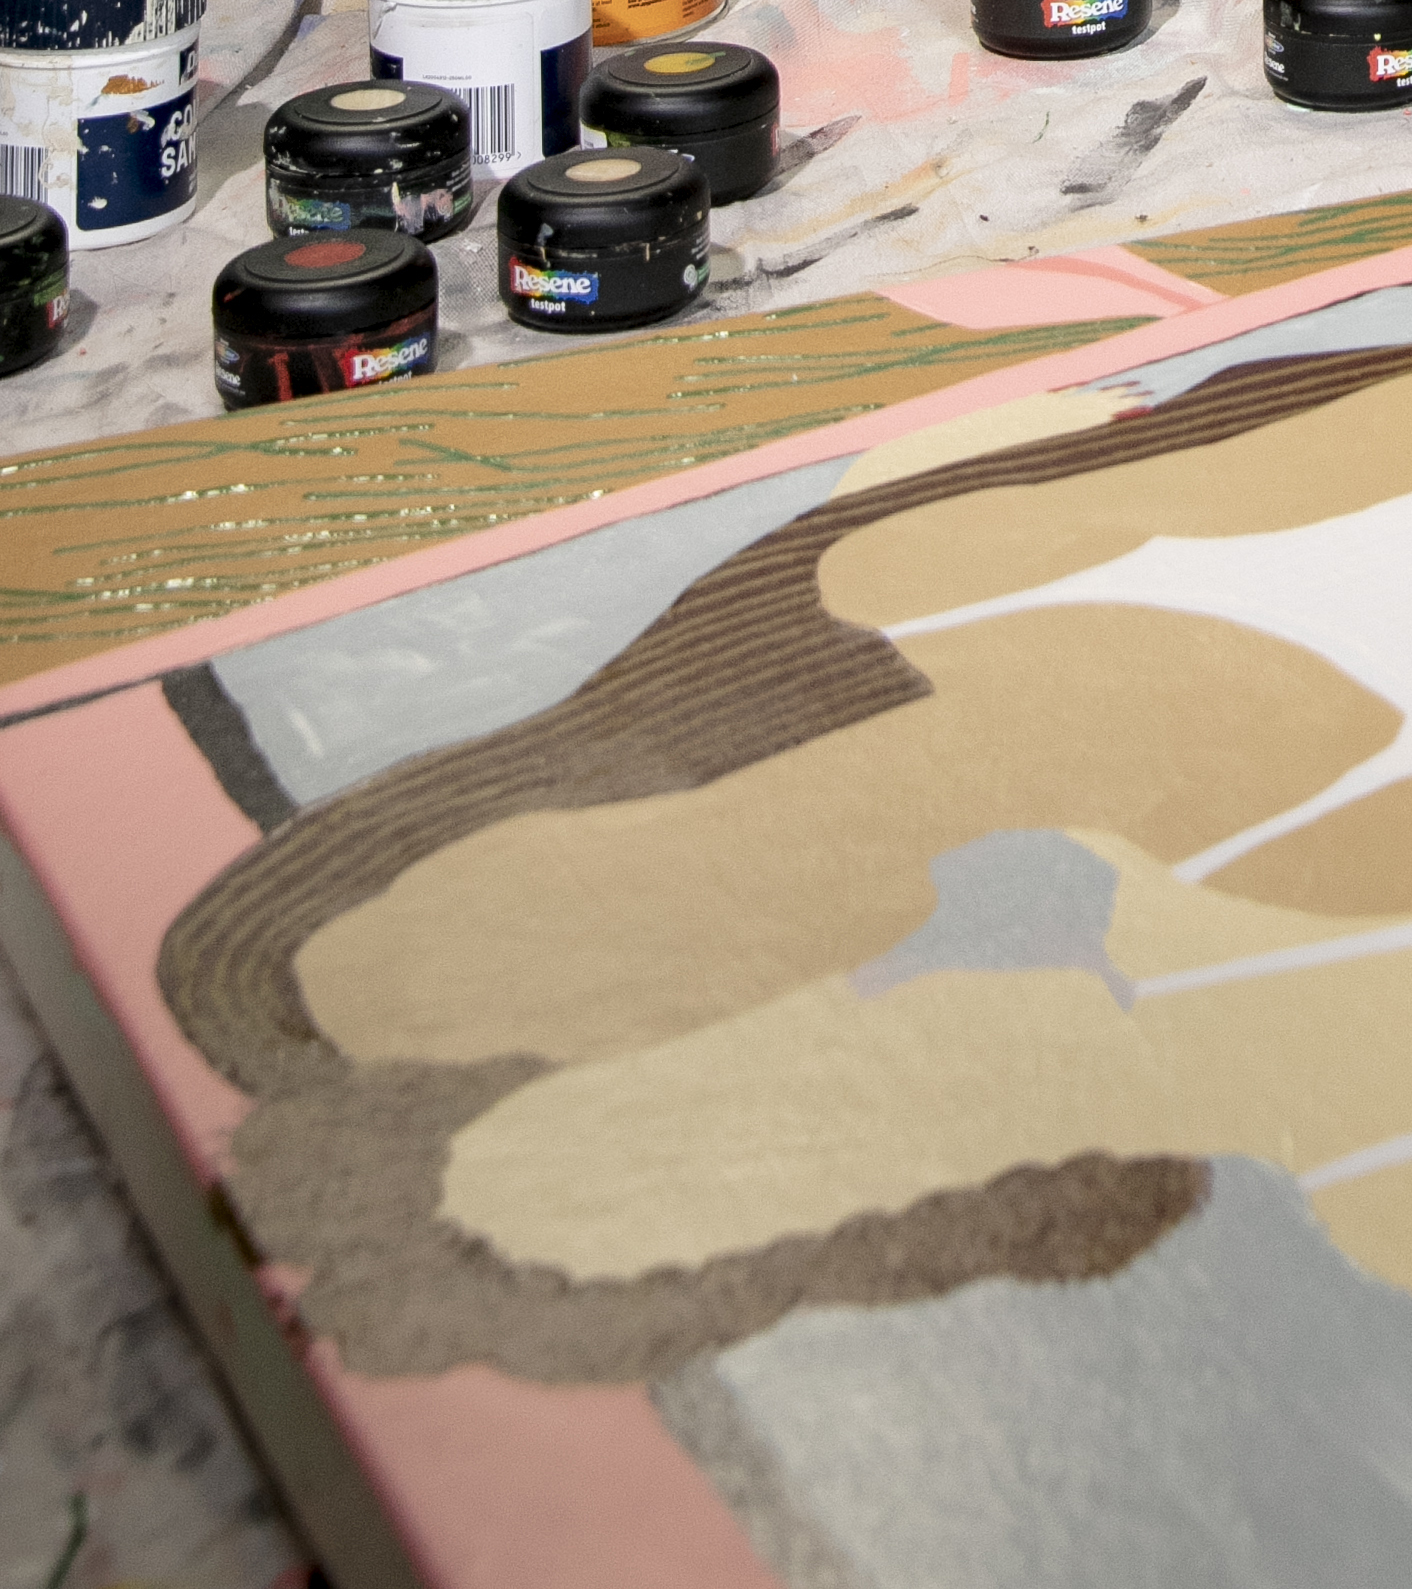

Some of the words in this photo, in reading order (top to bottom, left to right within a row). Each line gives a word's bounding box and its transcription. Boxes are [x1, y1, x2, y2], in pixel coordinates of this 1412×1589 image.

[1071, 21, 1106, 35] testpot
[514, 266, 591, 294] Resene
[530, 298, 566, 313] testpot
[352, 338, 428, 381] Resene
